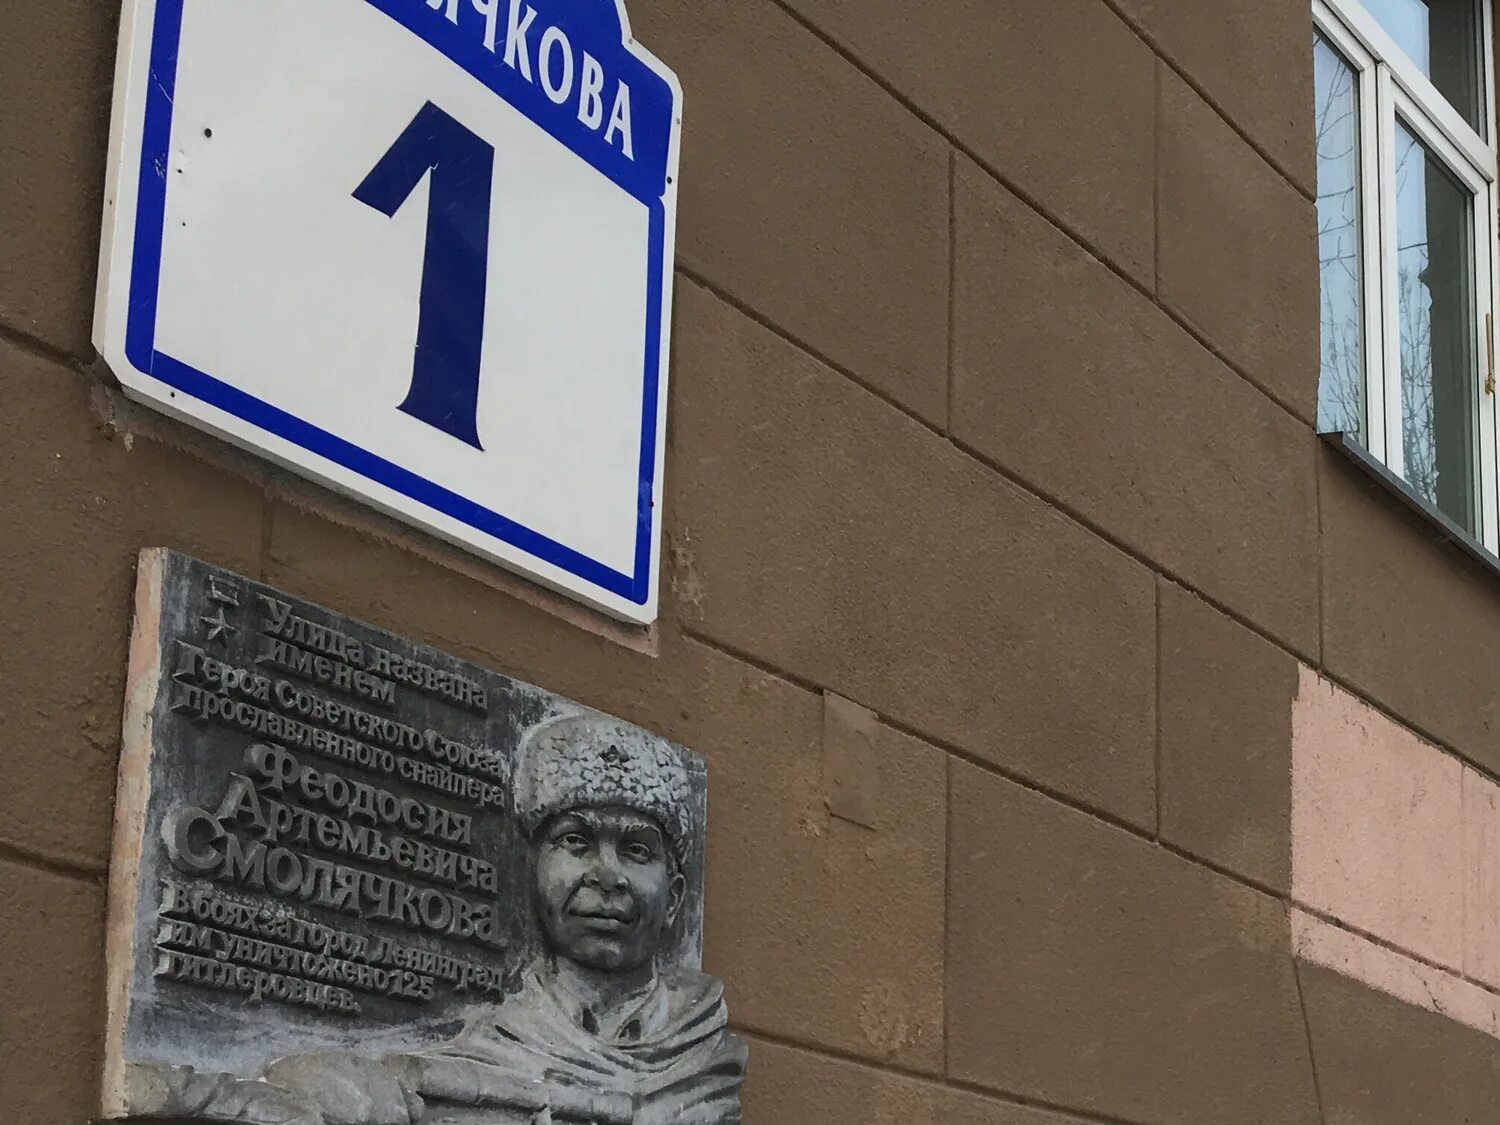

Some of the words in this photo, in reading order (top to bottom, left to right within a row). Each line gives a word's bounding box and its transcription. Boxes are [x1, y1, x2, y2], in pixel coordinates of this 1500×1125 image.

[350, 99, 495, 452] 1
[174, 641, 272, 701] Героя
[275, 679, 425, 751] Советского
[423, 728, 503, 777] Союза
[256, 592, 364, 666] Улица
[369, 643, 488, 710] названа
[260, 634, 397, 703] именем
[174, 684, 395, 773] прославленного
[398, 756, 505, 807] снайпера
[247, 742, 472, 845] Феодосия
[217, 772, 499, 893] Артемьевича
[160, 918, 212, 950] им
[213, 930, 389, 990] уничтожено
[388, 968, 435, 1001] 125
[191, 881, 259, 932] боях
[289, 917, 368, 960] город
[369, 933, 503, 992] Ленинград
